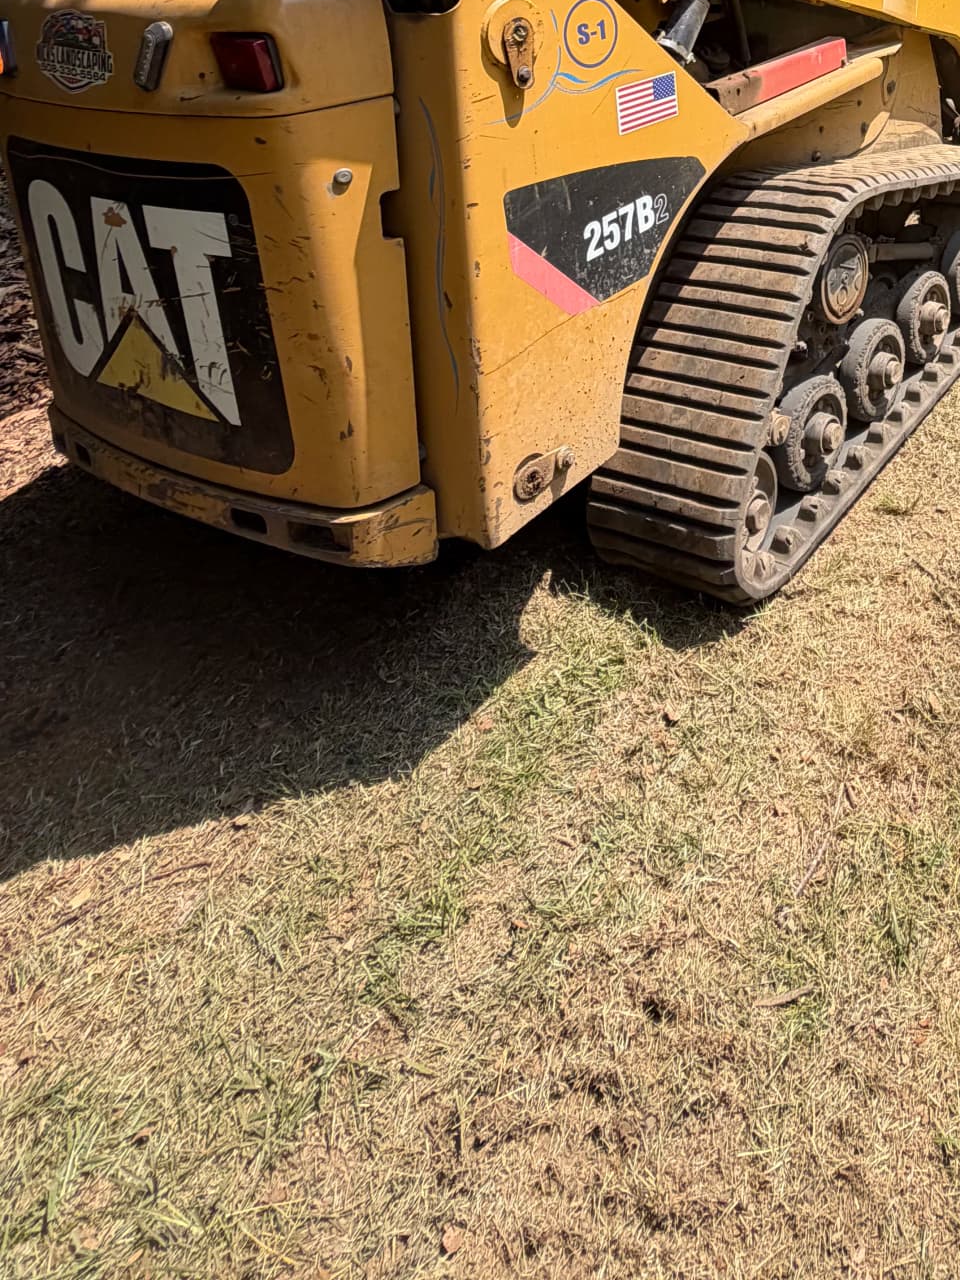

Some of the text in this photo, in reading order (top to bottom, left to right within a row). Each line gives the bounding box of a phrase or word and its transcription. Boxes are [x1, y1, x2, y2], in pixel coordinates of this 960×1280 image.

[576, 19, 606, 45] S-1
[56, 46, 113, 73] LANDSCAPING
[28, 179, 242, 426] CAT
